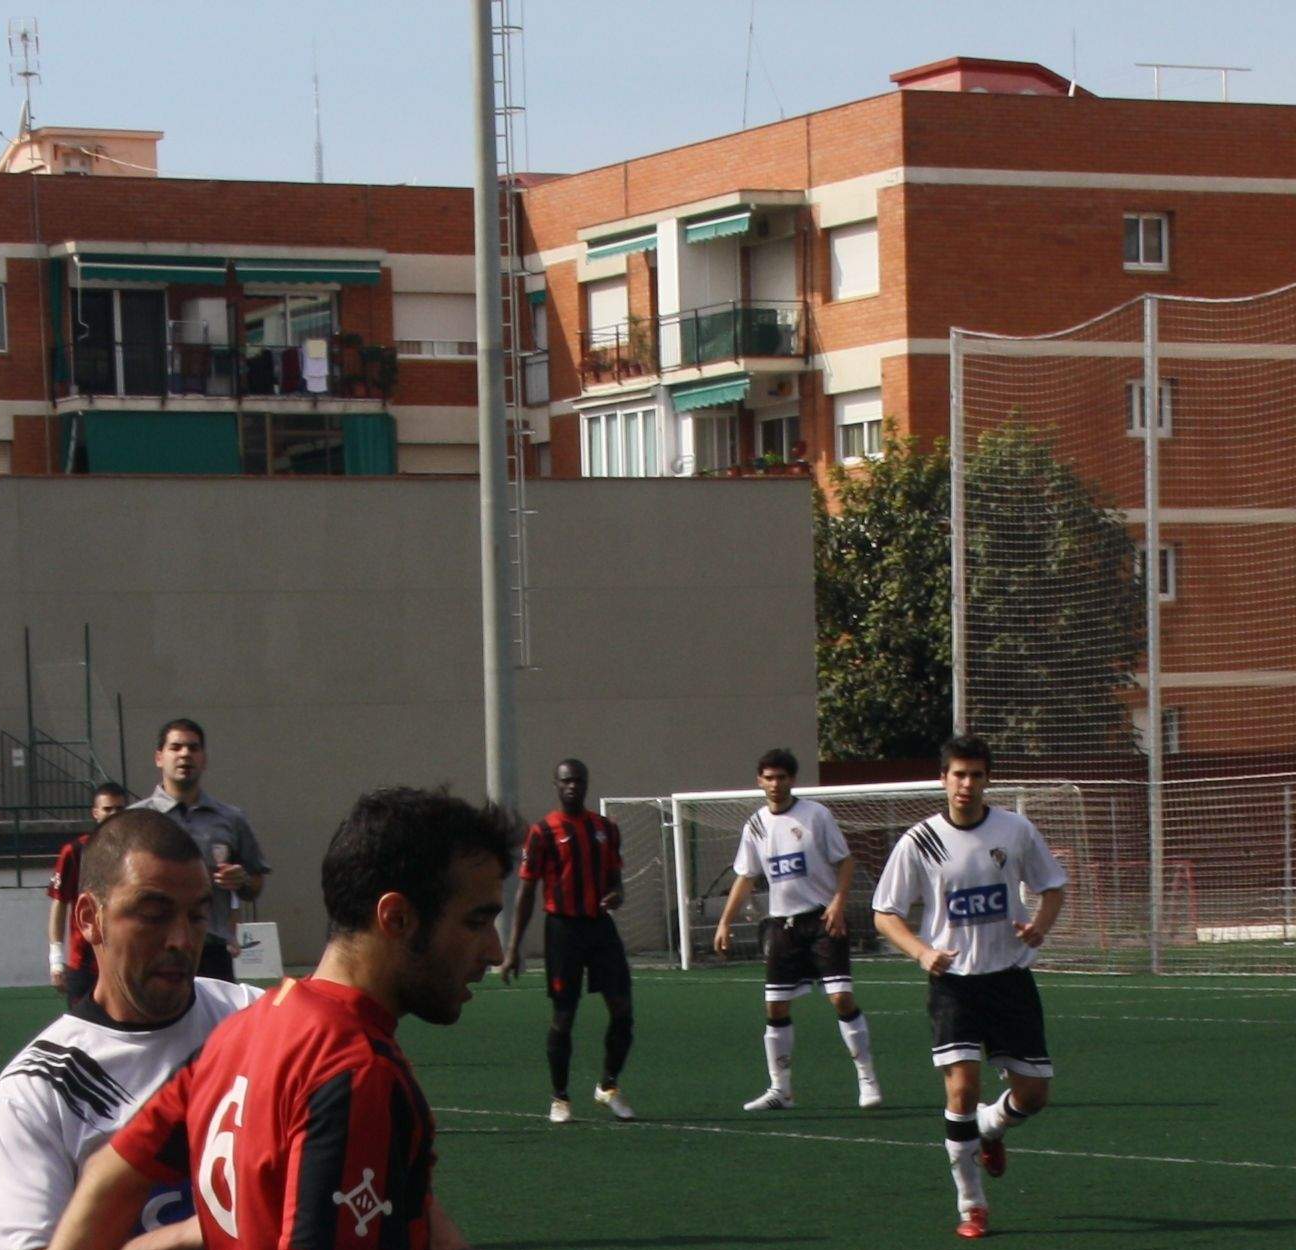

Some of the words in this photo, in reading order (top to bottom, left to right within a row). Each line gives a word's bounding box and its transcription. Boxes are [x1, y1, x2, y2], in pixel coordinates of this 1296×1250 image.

[769, 857, 803, 875] CRC
[949, 891, 1003, 915] CRC
[199, 1075, 249, 1239] 6
